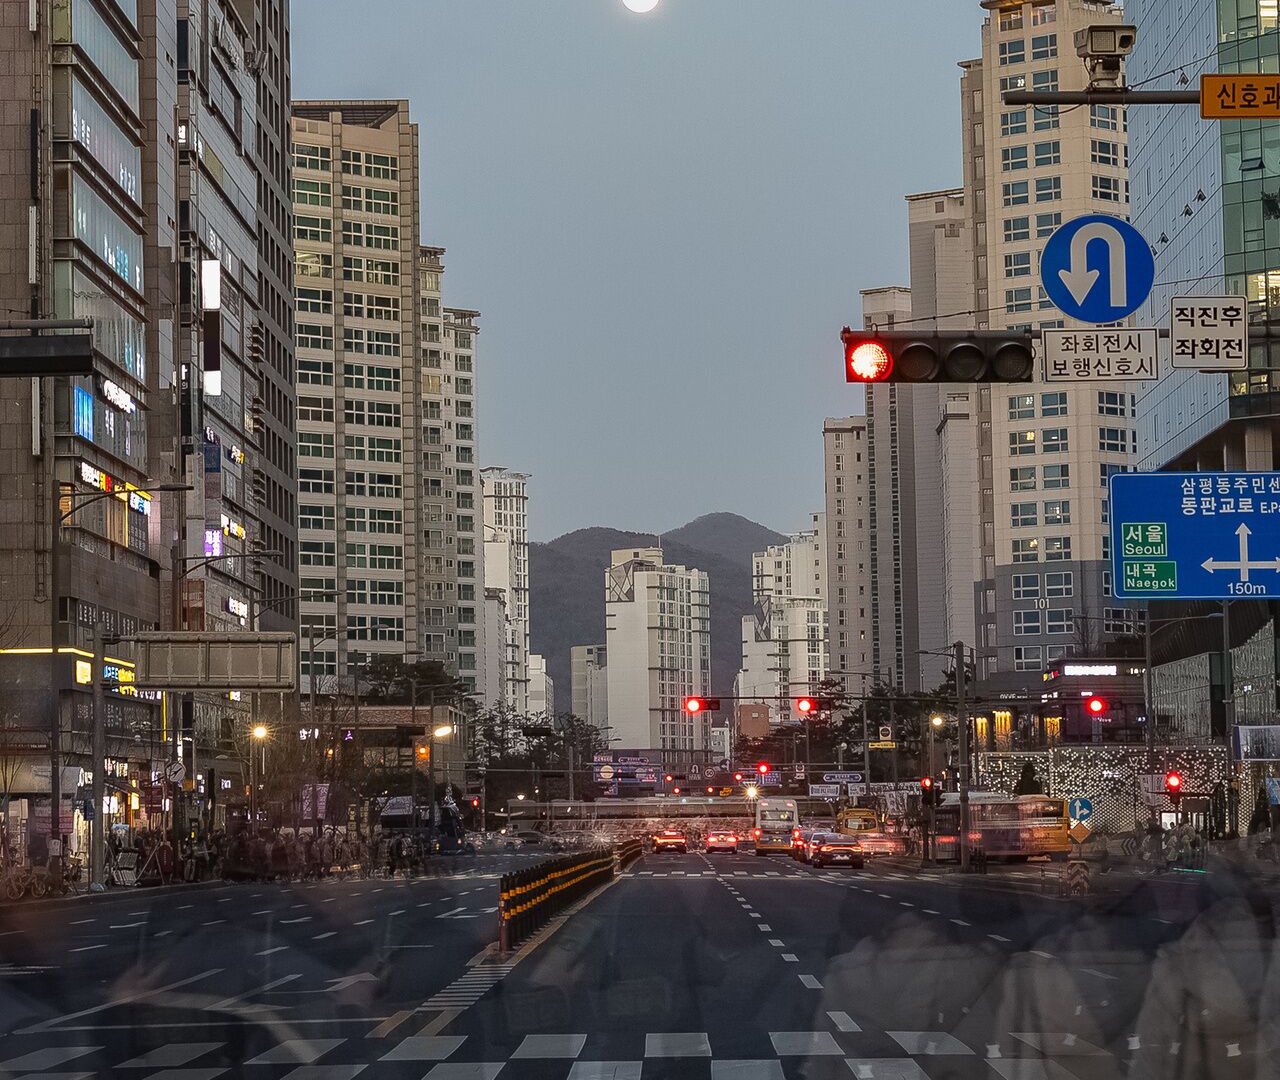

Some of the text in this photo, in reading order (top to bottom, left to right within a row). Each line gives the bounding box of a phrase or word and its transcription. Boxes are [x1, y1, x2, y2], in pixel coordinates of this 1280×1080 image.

[1173, 305, 1243, 328] 직진후
[1059, 334, 1144, 355] 좌회전시
[1174, 337, 1243, 361] 좌회전
[1050, 356, 1156, 379] 보행신호시
[1181, 497, 1254, 516] 동판교로
[1125, 525, 1164, 543] 서울
[1125, 543, 1165, 556] Seoul
[1126, 564, 1157, 578] 내곡
[1127, 578, 1175, 590] Naegok
[1227, 582, 1267, 595] 150m
[1034, 599, 1050, 609] 101
